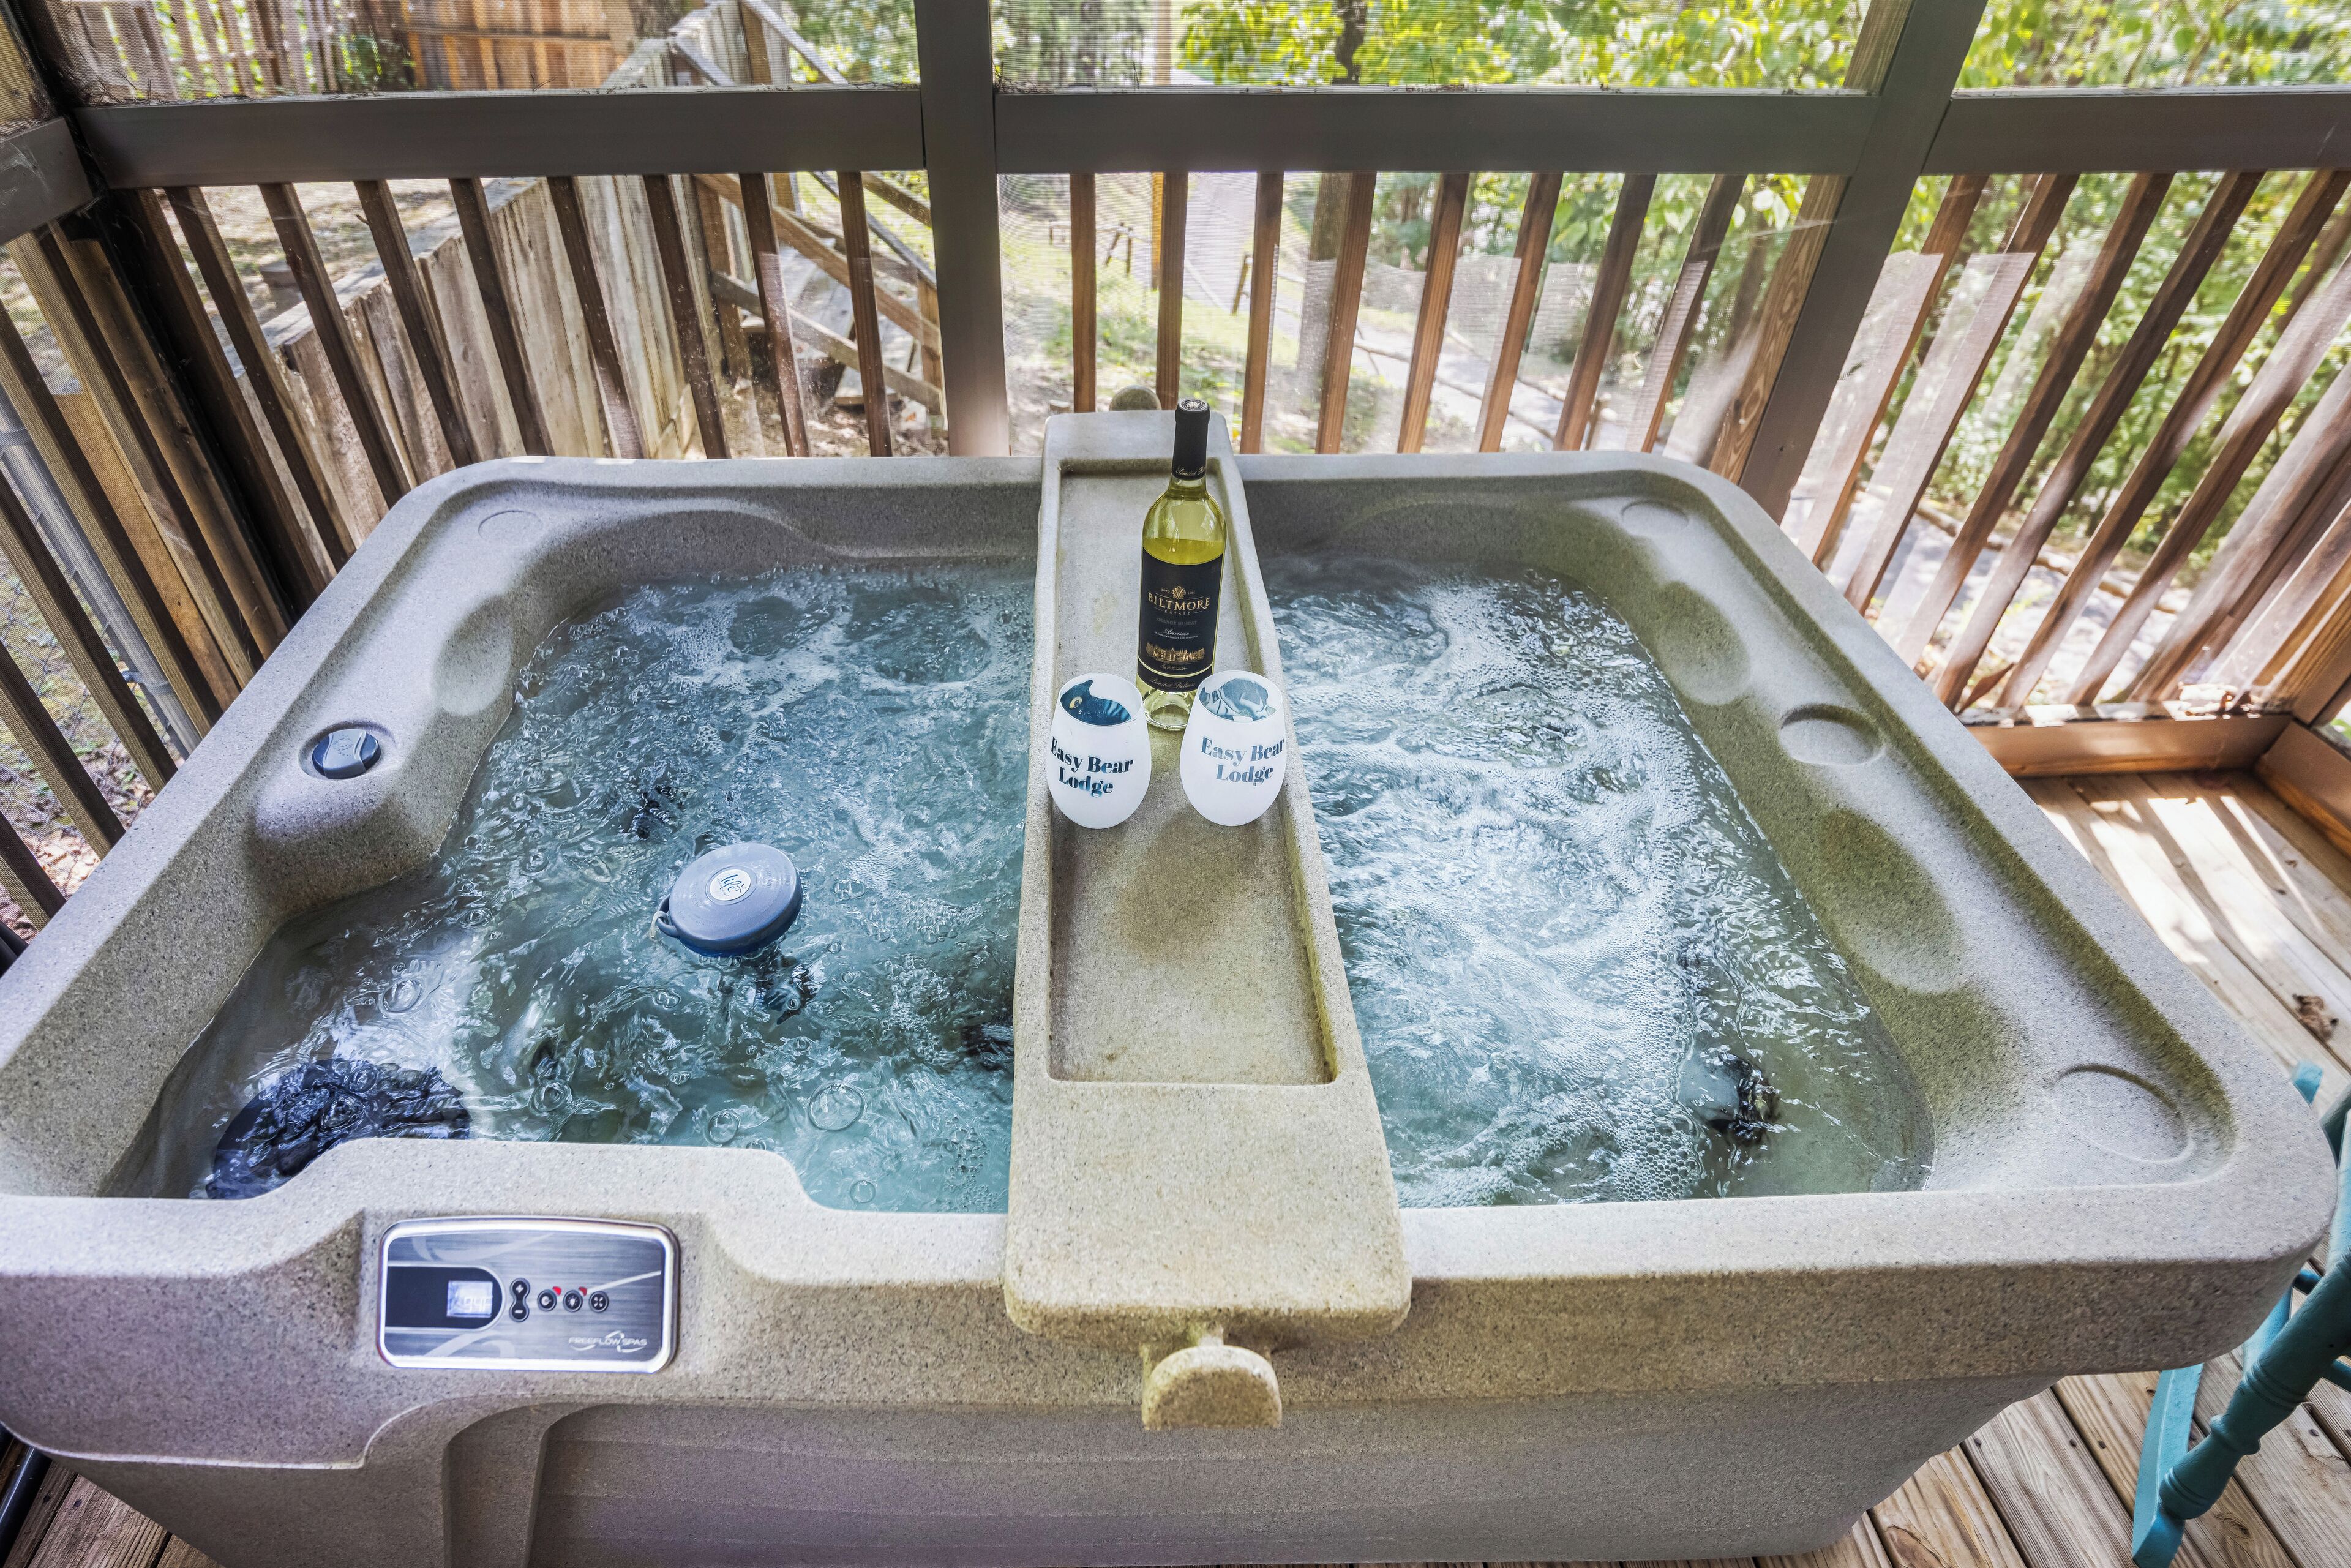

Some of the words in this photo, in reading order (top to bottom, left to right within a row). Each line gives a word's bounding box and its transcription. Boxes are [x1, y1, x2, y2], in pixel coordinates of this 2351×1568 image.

[1147, 591, 1210, 611] BILTMORE
[1051, 736, 1083, 773] Easy
[1087, 756, 1134, 775] Bear
[1201, 736, 1247, 767] Easy
[1250, 738, 1285, 762] Bear
[1059, 765, 1114, 798] Lodge
[1216, 764, 1273, 787] Lodge
[568, 1337, 621, 1345] FREEFLOW
